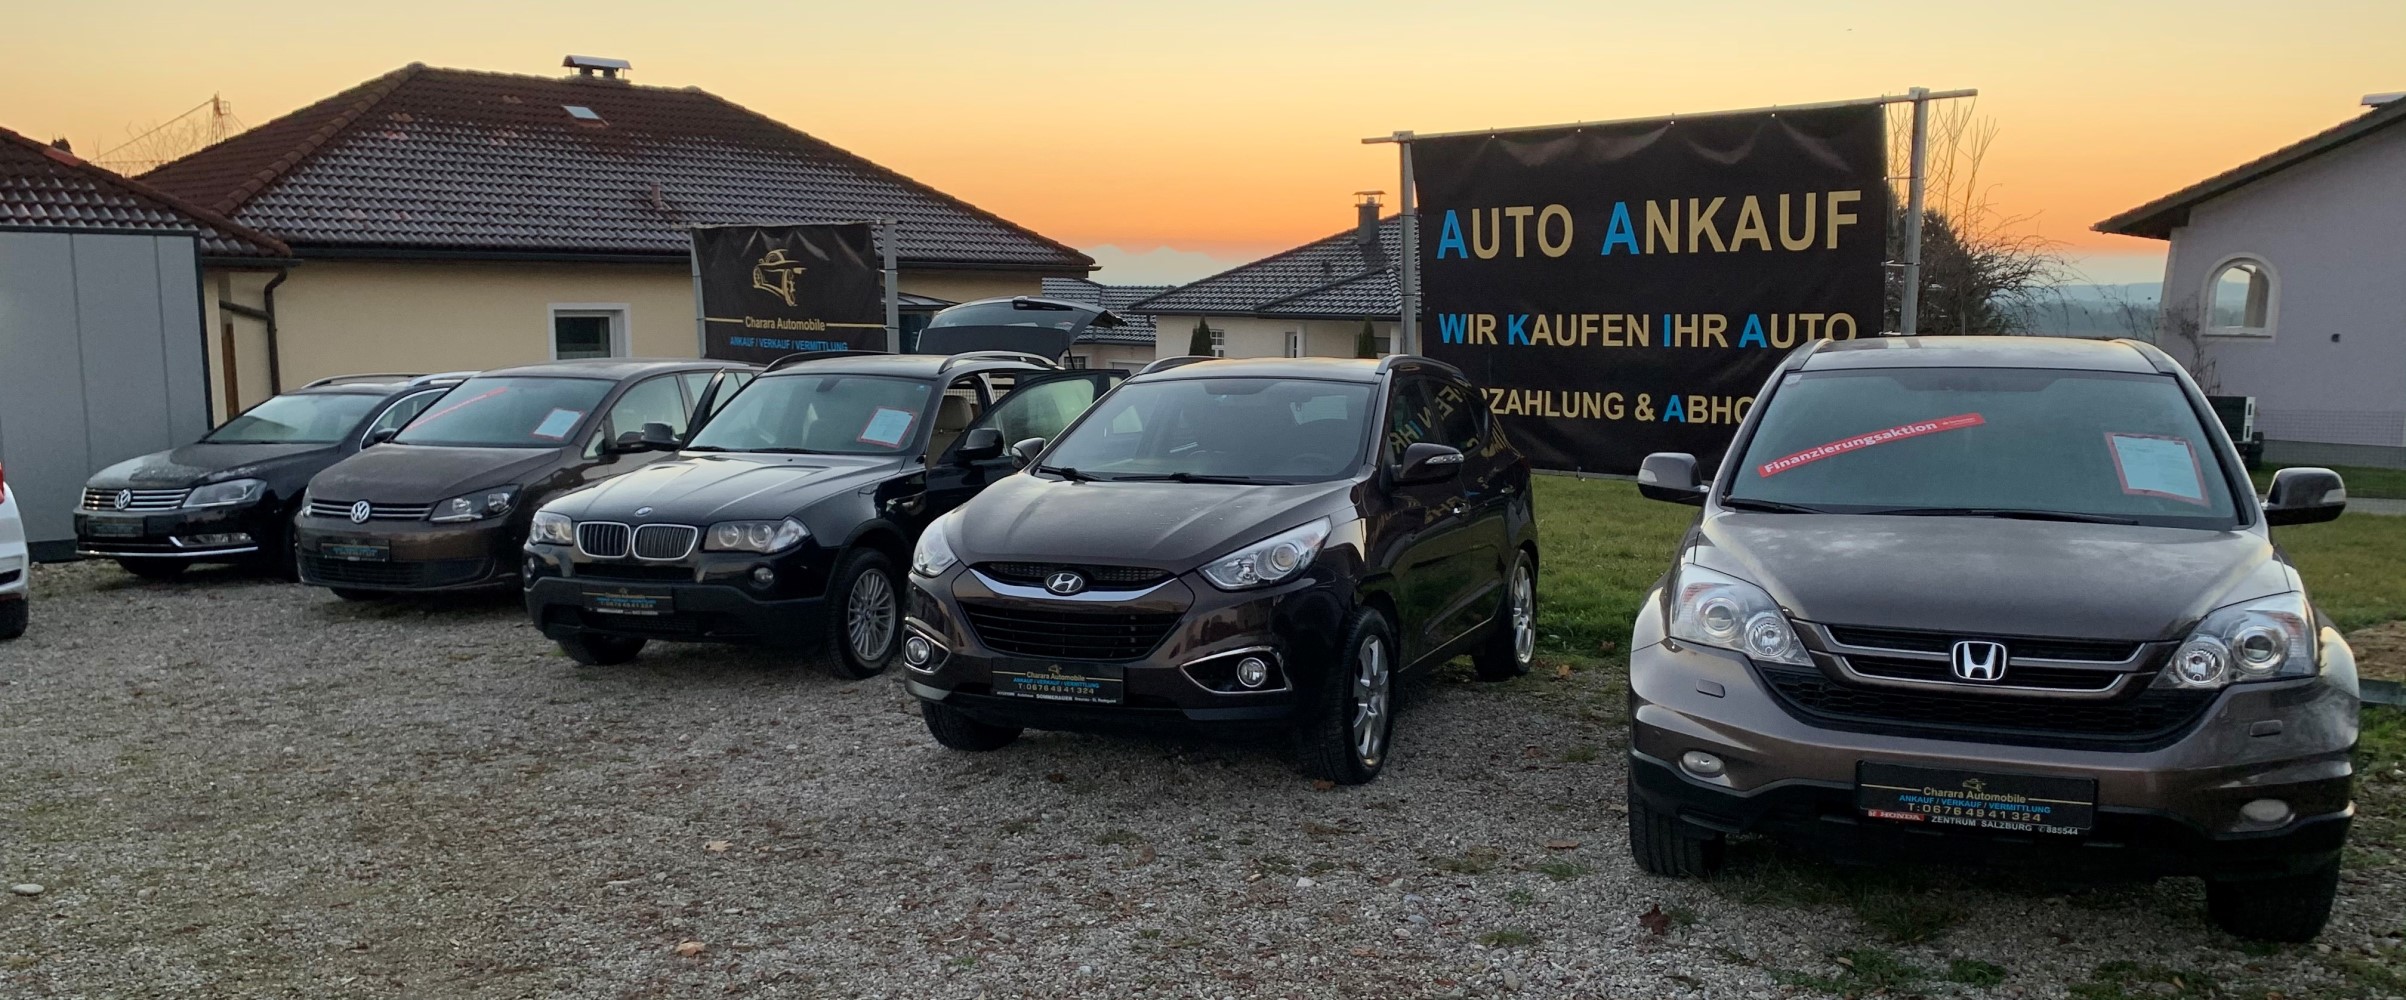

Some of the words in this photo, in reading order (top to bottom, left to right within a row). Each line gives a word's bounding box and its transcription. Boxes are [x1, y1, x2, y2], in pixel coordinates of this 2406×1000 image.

[1436, 203, 1574, 260] AUTO
[1601, 189, 1862, 256] ANKAUF
[744, 315, 776, 330] Charara
[776, 317, 826, 331] Automobile
[1438, 313, 1498, 345] WIR
[1507, 313, 1650, 347] KAUFEN
[1663, 313, 1729, 348] IHR
[1738, 312, 1857, 349] AUTO
[730, 336, 755, 347] ANKAUF
[759, 338, 791, 350] VERKAUF
[795, 340, 848, 352] VERMITTLUNG
[1480, 387, 1625, 420] ZAHLUNG
[1633, 391, 1656, 422] &
[1763, 421, 1938, 474] Finanzierungsaktion
[1899, 794, 1934, 804] ANKAUF
[1941, 798, 1982, 808] VERKAUF
[1988, 802, 2051, 814] VERMITTLUNG
[1923, 786, 1963, 799] Charara
[1966, 790, 2026, 804] Automobile
[1880, 811, 1921, 821] HONDA
[1931, 815, 1976, 827] ZENTRUM
[1981, 819, 2033, 832] SALZBURG
